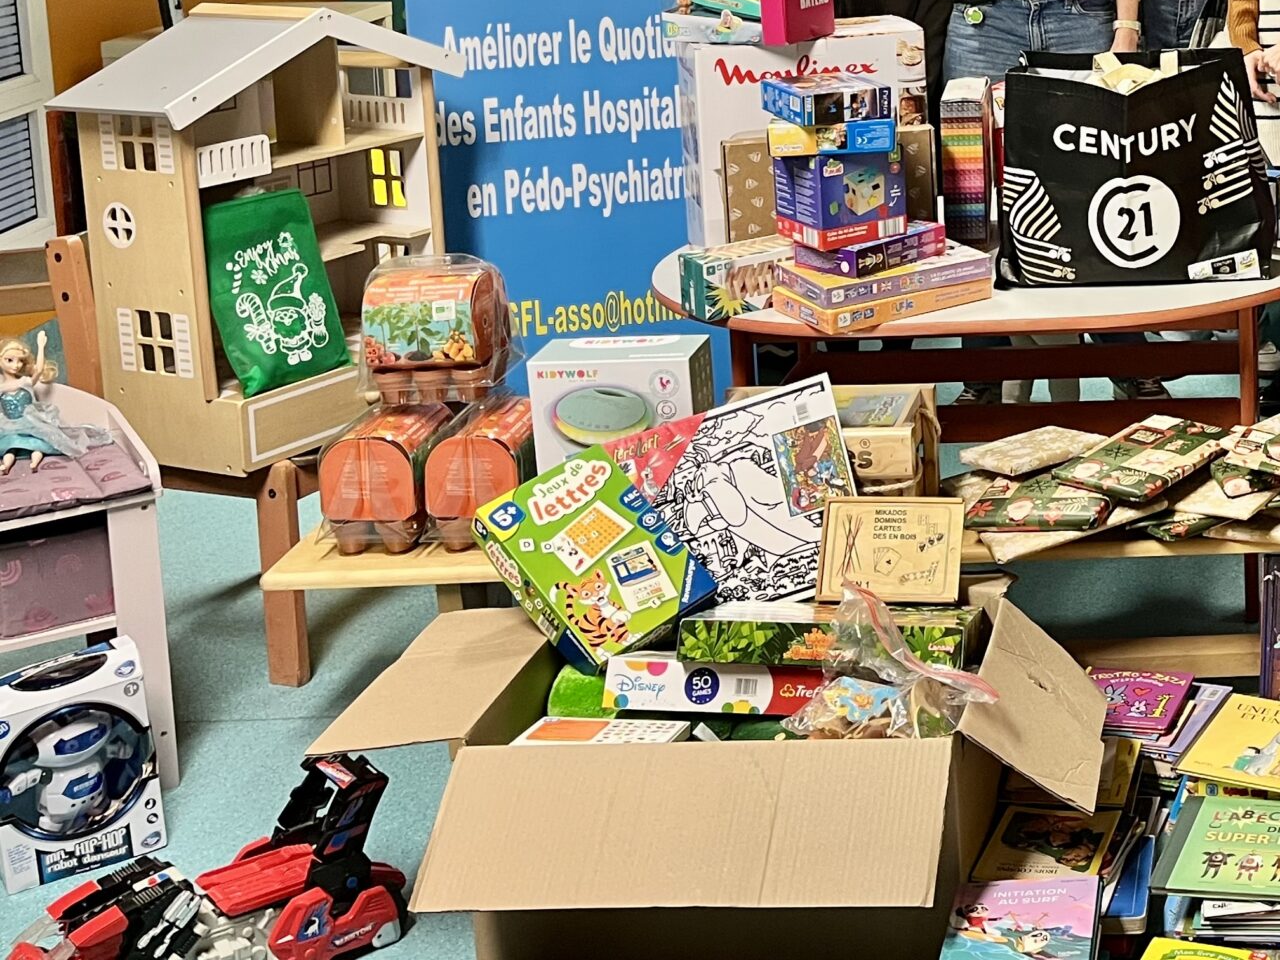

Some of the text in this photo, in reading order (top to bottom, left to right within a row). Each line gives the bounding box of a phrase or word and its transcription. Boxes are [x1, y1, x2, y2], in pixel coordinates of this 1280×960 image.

[444, 24, 562, 71] Améliorer
[569, 19, 592, 63] le
[714, 54, 878, 86] Moulinex
[483, 94, 577, 143] Enfants
[583, 85, 682, 143] Hospital
[1053, 113, 1197, 163] CENTURY
[467, 180, 498, 218] en
[1118, 202, 1153, 241] 21
[537, 369, 598, 379] KIDYWOLF
[533, 465, 606, 521] lettres
[538, 463, 583, 498] Jeux de
[623, 490, 640, 503] ABC
[493, 506, 517, 526] 5+
[488, 544, 521, 586] lettres
[692, 676, 711, 689] 50
[692, 688, 711, 696] GAMES
[1237, 703, 1272, 716] UNE
[1241, 712, 1257, 721] ET
[74, 827, 128, 855] HIP-HOP
[1205, 830, 1269, 844] SUPER
[47, 858, 78, 874] robot
[82, 847, 128, 864] danseur
[993, 888, 1066, 899] INITIATION
[998, 895, 1060, 905] AU SURF
